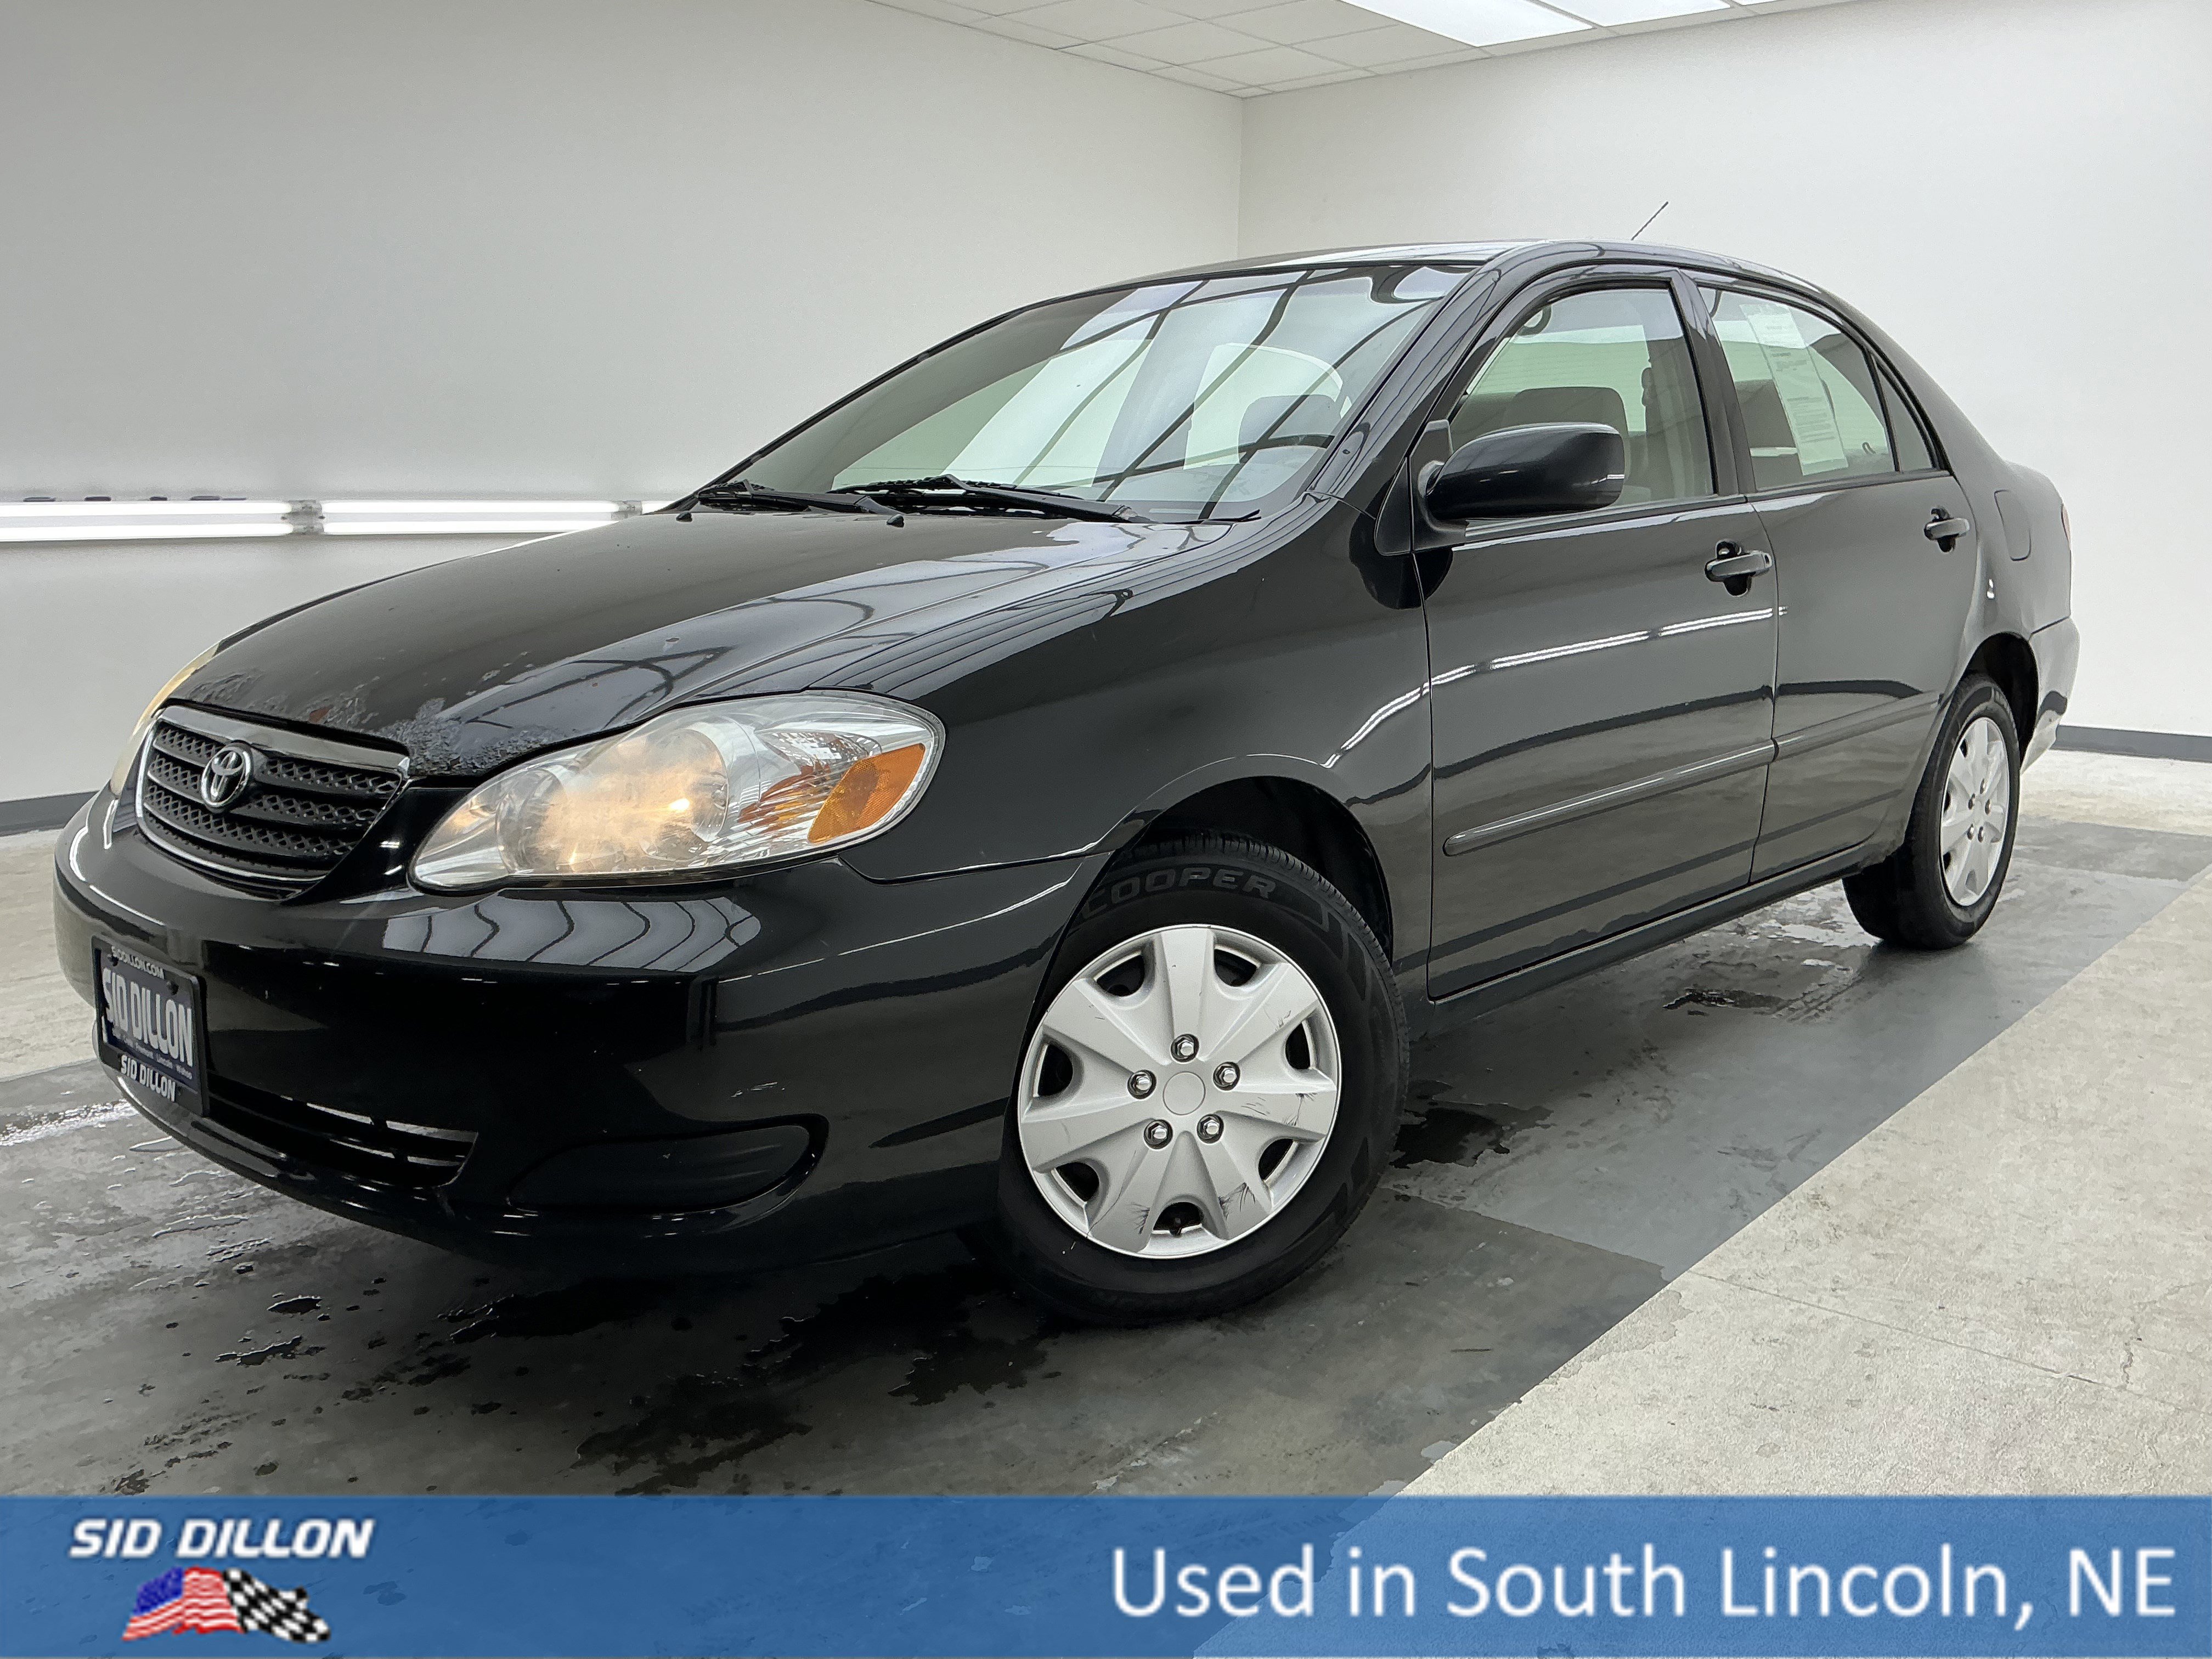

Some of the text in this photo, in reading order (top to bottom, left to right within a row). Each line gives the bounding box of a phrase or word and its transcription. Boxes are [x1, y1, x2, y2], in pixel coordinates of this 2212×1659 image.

[1084, 866, 1277, 918] COOPER
[102, 967, 193, 1068] SID DILLON
[120, 1054, 138, 1081] SID
[139, 1063, 176, 1102] DILLON
